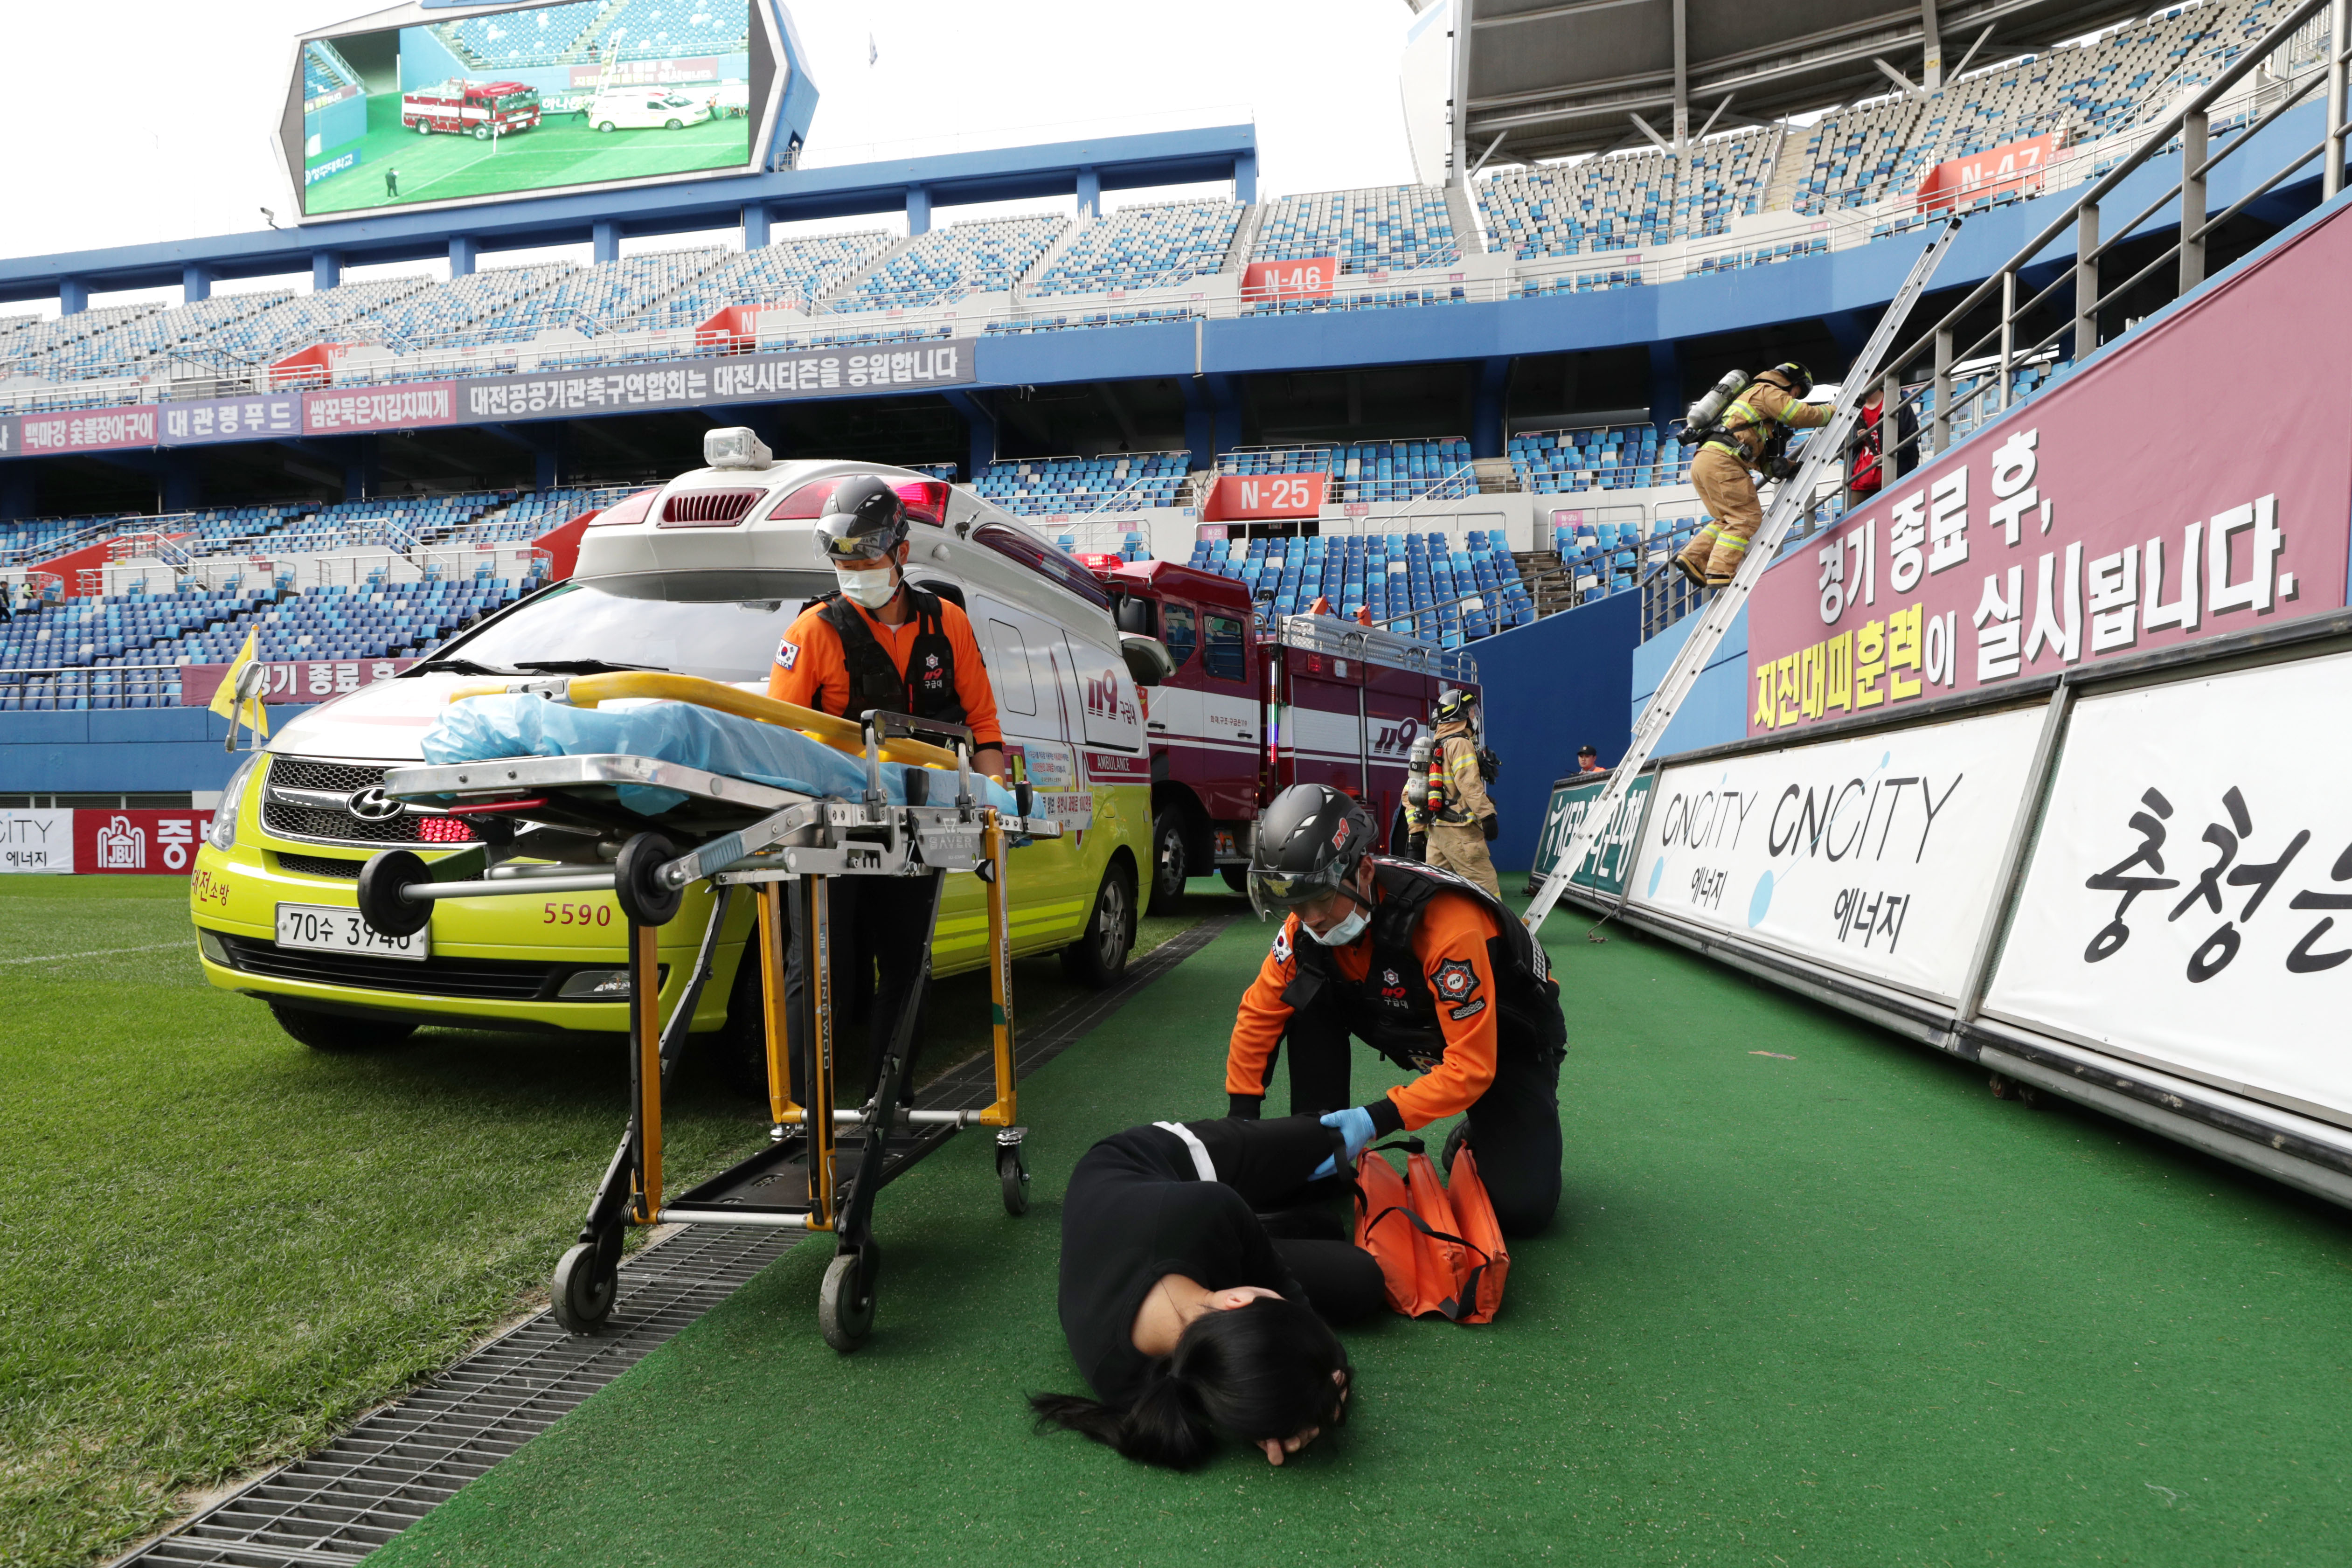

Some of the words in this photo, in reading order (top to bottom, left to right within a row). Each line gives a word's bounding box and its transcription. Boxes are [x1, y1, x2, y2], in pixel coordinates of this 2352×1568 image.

[1962, 146, 2040, 193] N-47
[1264, 266, 1321, 294] N-46
[470, 370, 707, 416] 대전공공기관축구연합회는
[714, 357, 840, 396] 대전시티즌을
[848, 347, 958, 387] 응원합니다
[25, 419, 67, 448] 백마강
[1241, 479, 1310, 510] N-25
[1818, 518, 1878, 626] 경기
[1889, 465, 1970, 594] 종료
[1989, 428, 2052, 547] 후,
[1754, 602, 1956, 729] 지진대피훈련이
[1972, 493, 2297, 682] 실시됩니다.
[308, 663, 360, 695] 종료
[923, 668, 943, 680] 119
[925, 680, 943, 689] 구급대
[1086, 669, 1117, 720] 119
[1120, 698, 1137, 726] 구급대
[1374, 718, 1418, 756] 119
[1097, 755, 1130, 771] AMBULANCE
[1662, 791, 1758, 851] CNCITY
[1768, 772, 1963, 864] CNCITY
[929, 836, 972, 850] SAVER
[1332, 817, 1350, 851] 119
[6, 850, 47, 867] 에너지
[108, 845, 135, 864] JBU
[192, 868, 212, 902] 대전
[209, 881, 229, 906] 소방
[543, 902, 611, 927] 5590
[1691, 866, 1728, 910] 에너지
[1833, 887, 1911, 954] 에너지
[290, 912, 333, 942] 70수
[1381, 987, 1406, 999] 119
[1450, 976, 1462, 986] 119
[1384, 997, 1408, 1009] 구급대
